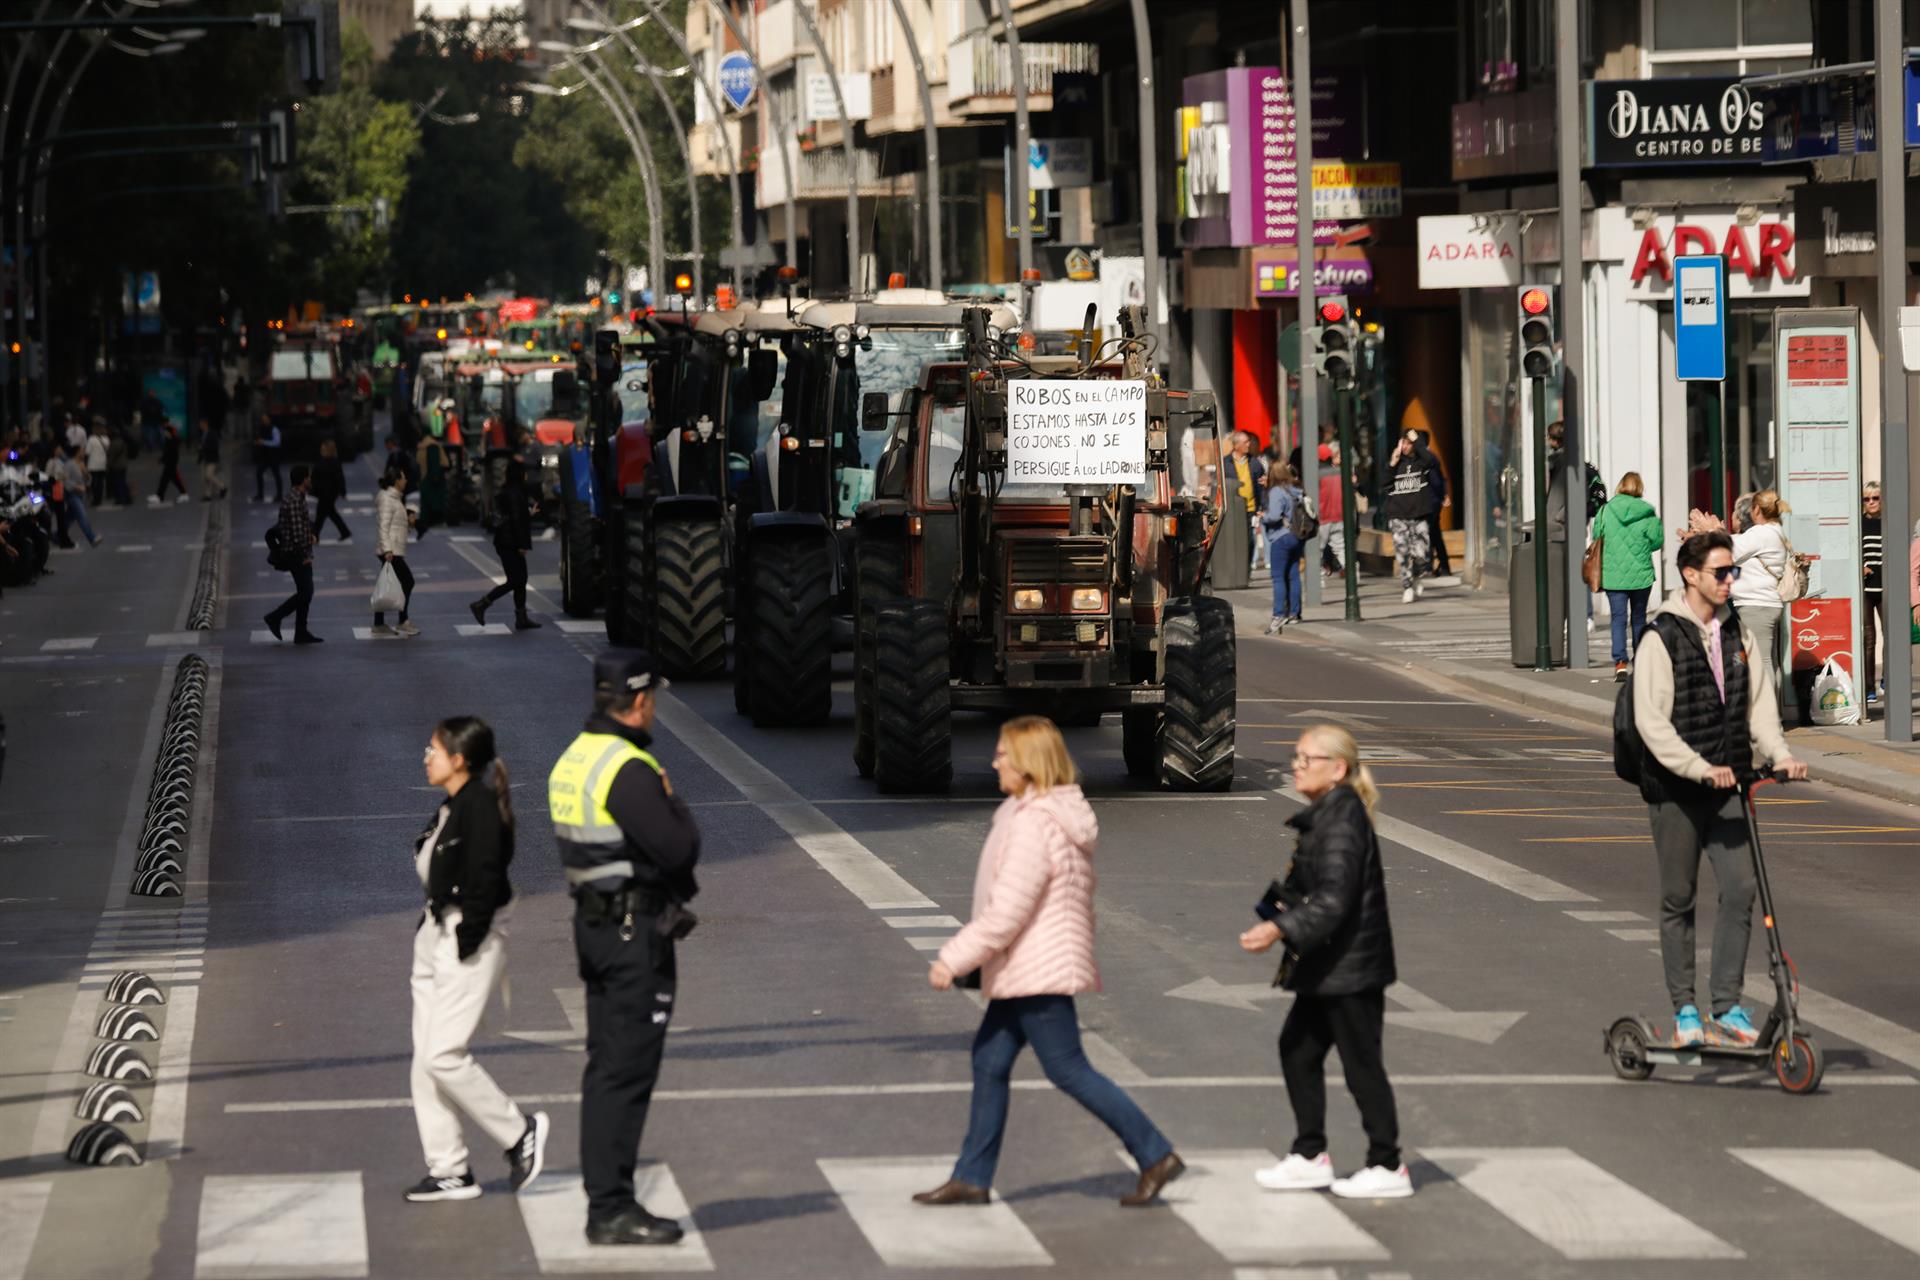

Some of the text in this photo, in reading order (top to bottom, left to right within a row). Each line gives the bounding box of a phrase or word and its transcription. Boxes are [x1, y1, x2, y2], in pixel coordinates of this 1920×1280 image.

[1608, 90, 1709, 139] DIANA
[1636, 137, 1762, 157] CENTRO DE BE
[1427, 240, 1516, 261] ADARA
[1288, 264, 1368, 291] pofusa
[1016, 386, 1144, 406] ROBOS EN EL CAMPO
[1013, 412, 1136, 430] ESTAMOS HASTA LOS
[1081, 434, 1096, 447] NO
[1103, 433, 1120, 447] SE
[1014, 460, 1145, 476] PERSIGUE A LOS LADRONES
